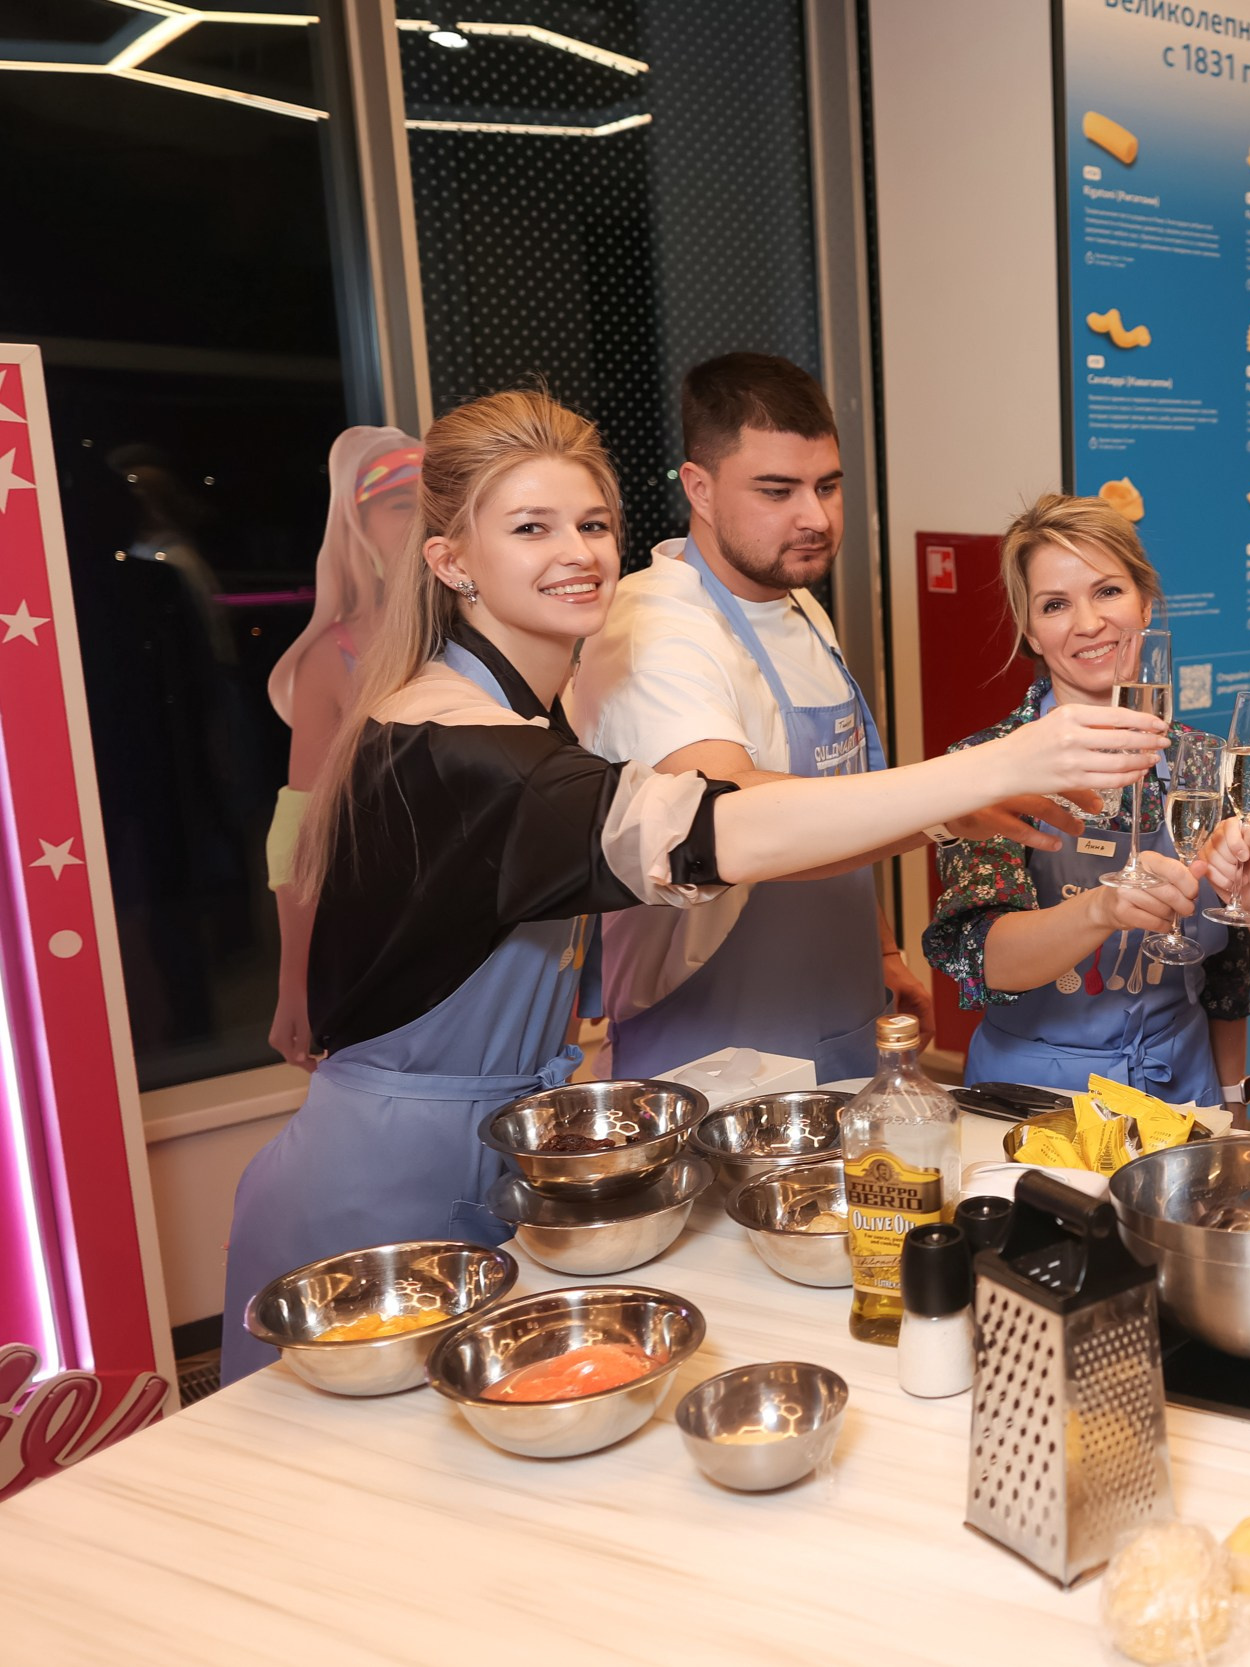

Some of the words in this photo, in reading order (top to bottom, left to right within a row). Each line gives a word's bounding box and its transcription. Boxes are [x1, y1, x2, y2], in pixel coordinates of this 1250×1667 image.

[1163, 45, 1176, 68] с
[1182, 43, 1236, 80] 1831
[848, 1190, 923, 1211] BERIO
[850, 1182, 918, 1198] FILIPPO
[852, 1209, 893, 1231] OLIVE
